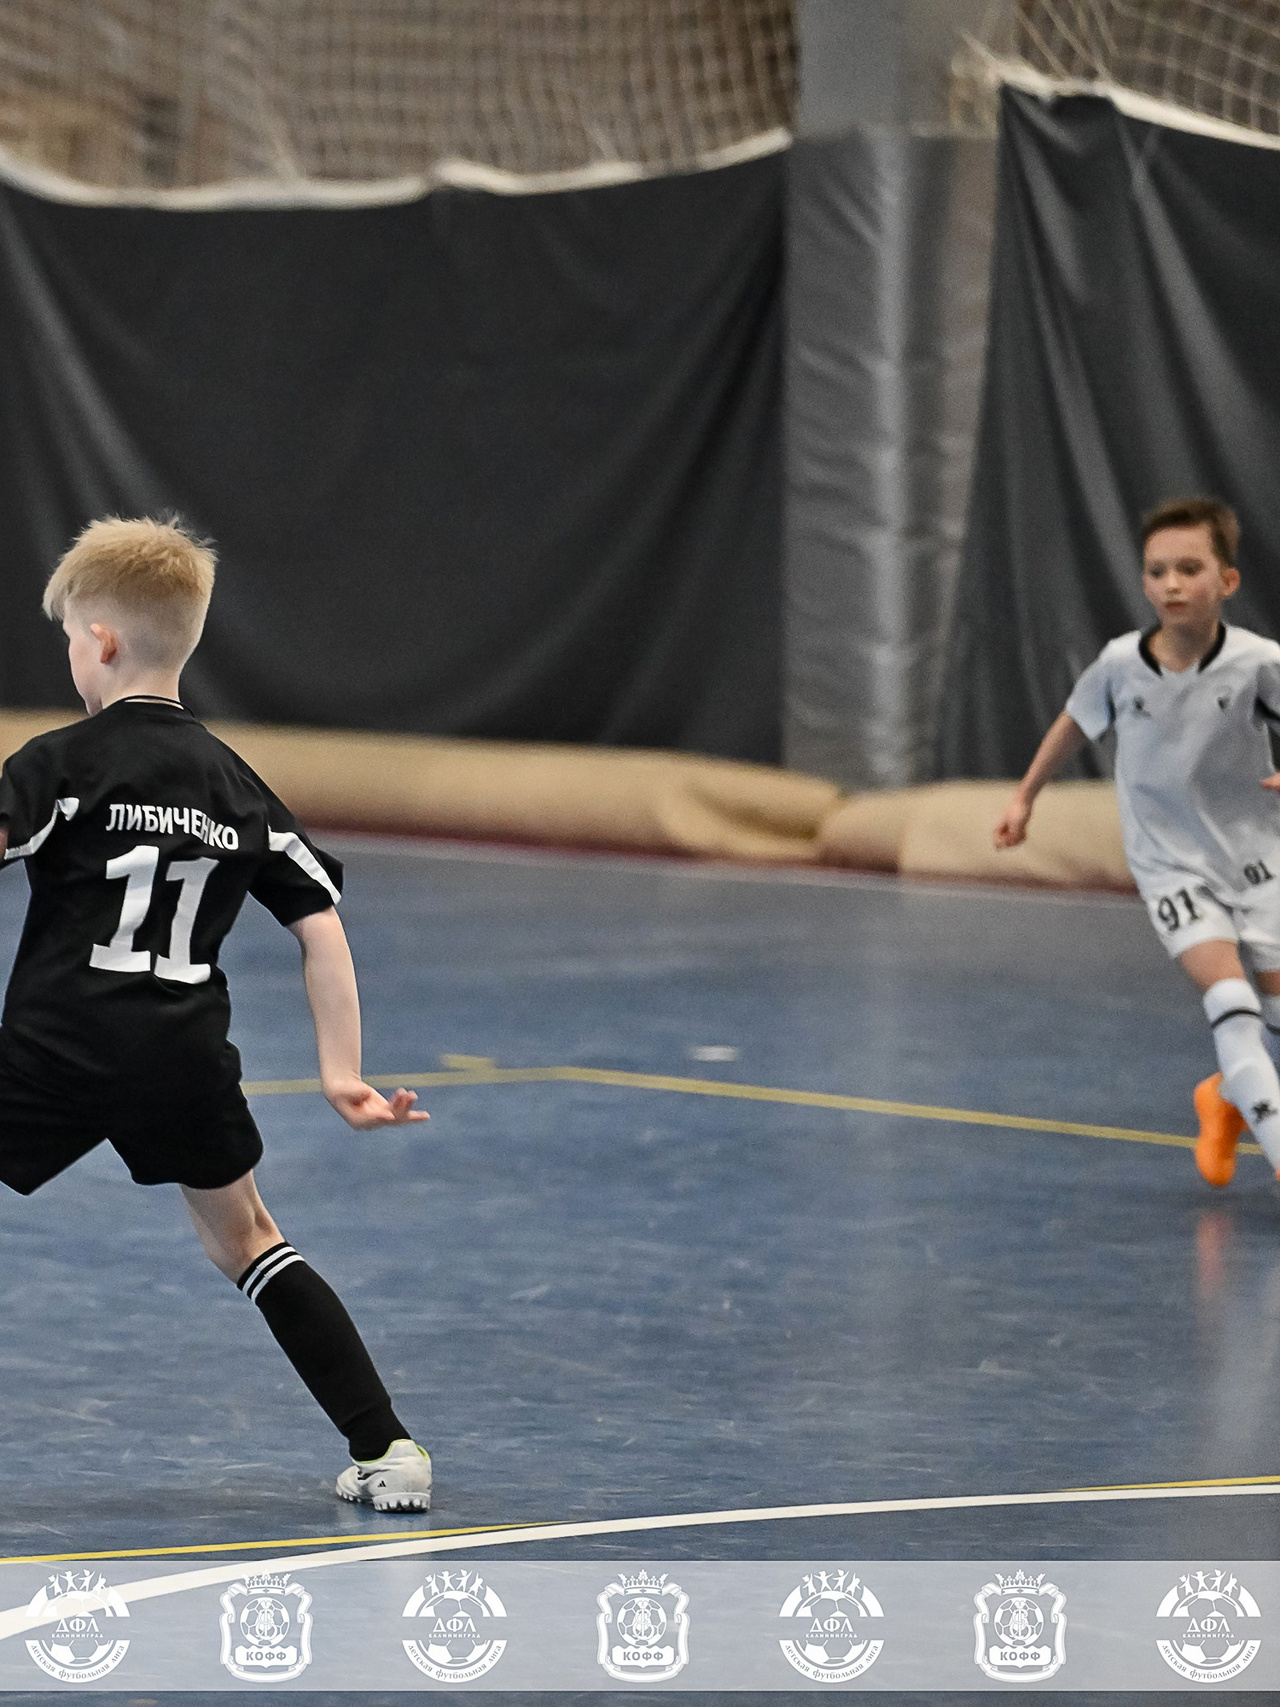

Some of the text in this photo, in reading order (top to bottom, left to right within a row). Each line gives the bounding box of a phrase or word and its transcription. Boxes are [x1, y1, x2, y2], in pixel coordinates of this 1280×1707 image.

[106, 804, 239, 850] ЛИБИЧЕНКО
[89, 845, 220, 984] 11
[1158, 886, 1200, 931] 91
